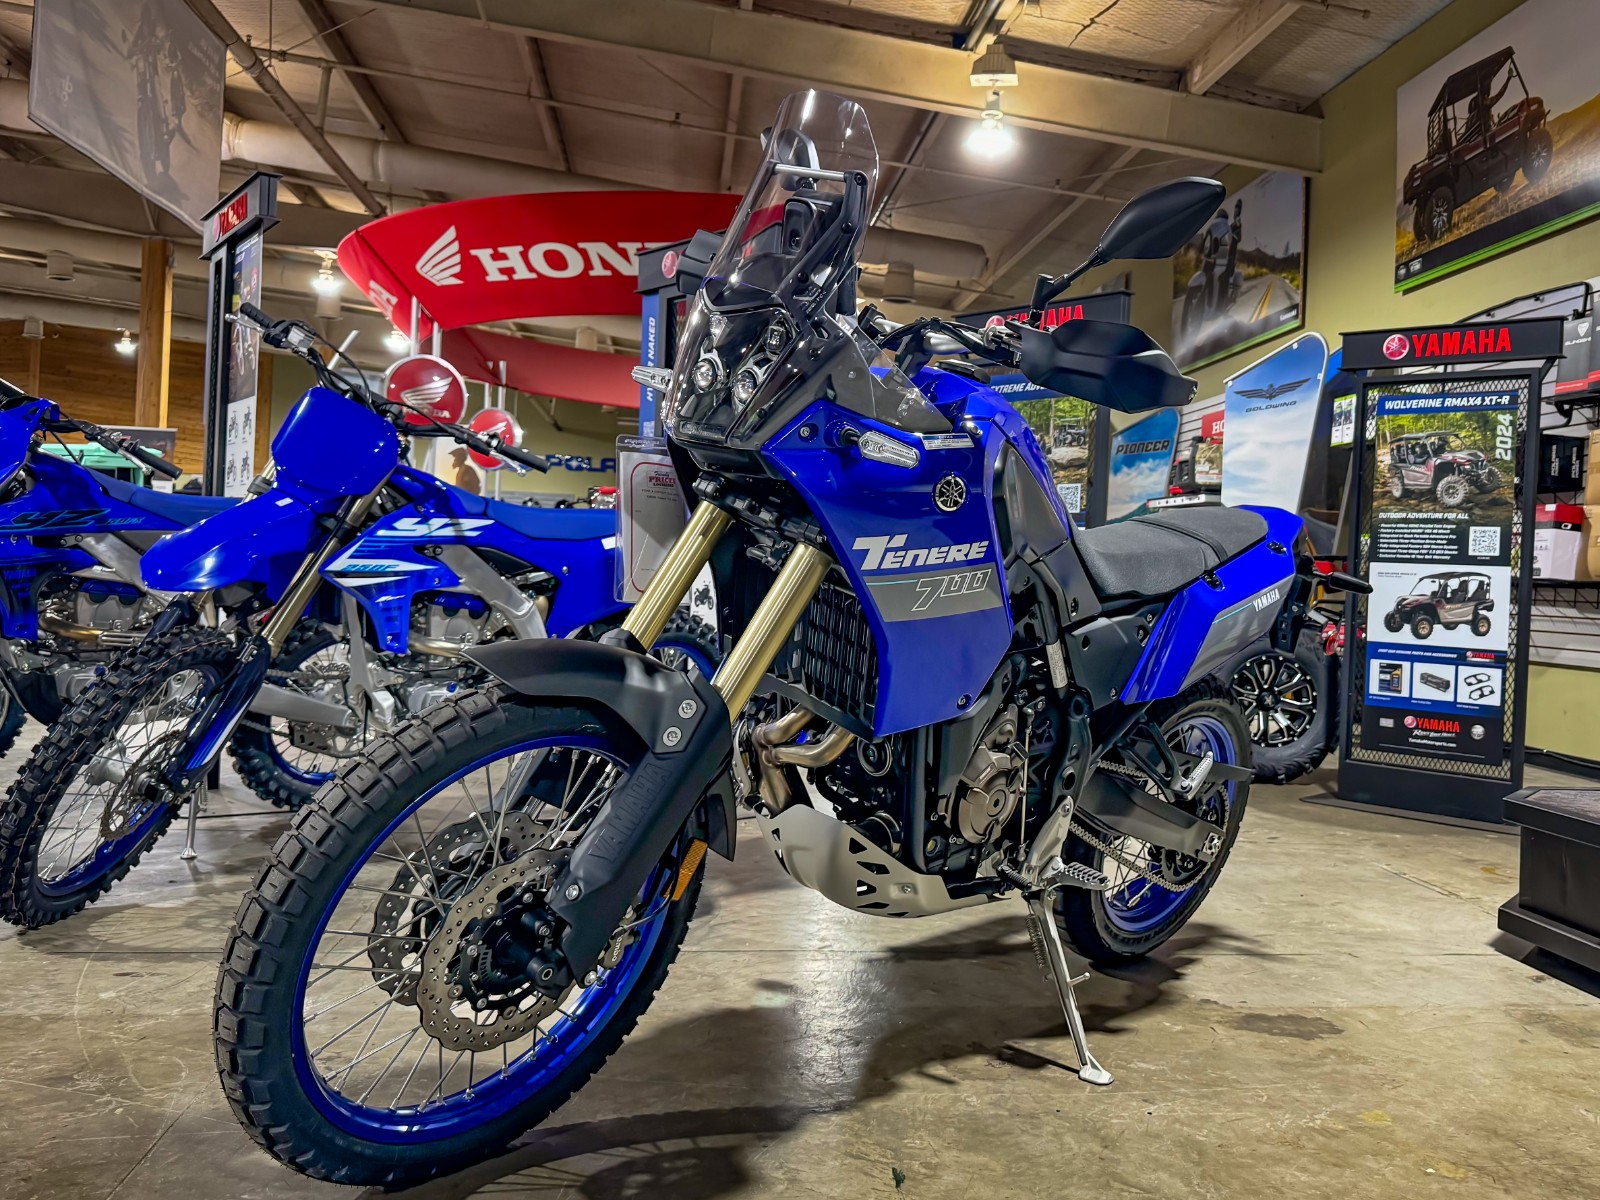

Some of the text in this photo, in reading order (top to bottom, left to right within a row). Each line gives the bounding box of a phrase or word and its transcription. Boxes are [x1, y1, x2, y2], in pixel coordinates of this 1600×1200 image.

[469, 241, 674, 282] HON
[1007, 304, 1084, 331] YAAHA
[647, 316, 656, 360] NAKED
[1412, 327, 1512, 358] YAMAHA
[1245, 400, 1297, 413] GOLDWING
[1384, 395, 1510, 410] WOLVERINE RMAX4 XT-R
[1212, 420, 1225, 434] HO
[1495, 413, 1513, 461] 2024
[1115, 439, 1170, 455] PIONEER
[545, 454, 617, 473] POLA
[911, 568, 992, 612] 700
[1252, 588, 1280, 612] YAMAHA
[1417, 717, 1460, 733] YAMAHA
[588, 762, 673, 863] YAMAHA
[612, 935, 624, 961] embo
